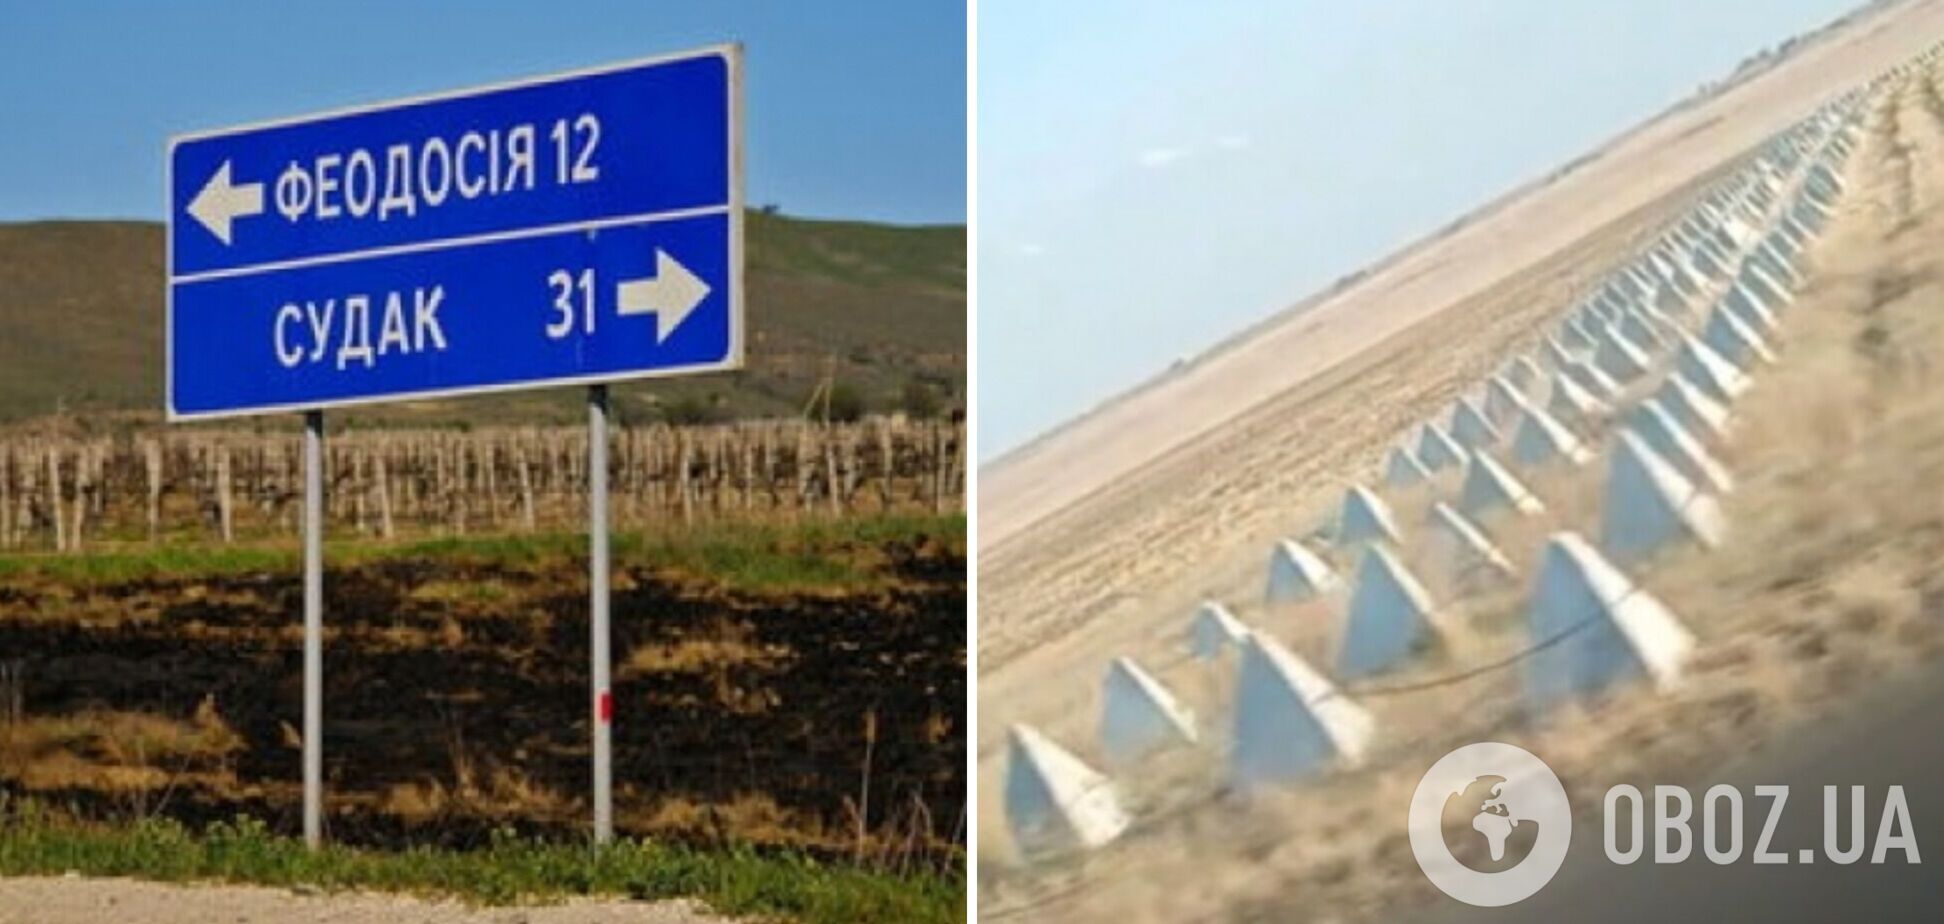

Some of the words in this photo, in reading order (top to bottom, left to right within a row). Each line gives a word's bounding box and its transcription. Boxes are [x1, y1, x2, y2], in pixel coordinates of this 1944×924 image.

[275, 125, 536, 223] ФЕОДОСІЯ
[550, 114, 600, 184] 12
[273, 285, 447, 369] СУДАК
[546, 268, 596, 339] 31
